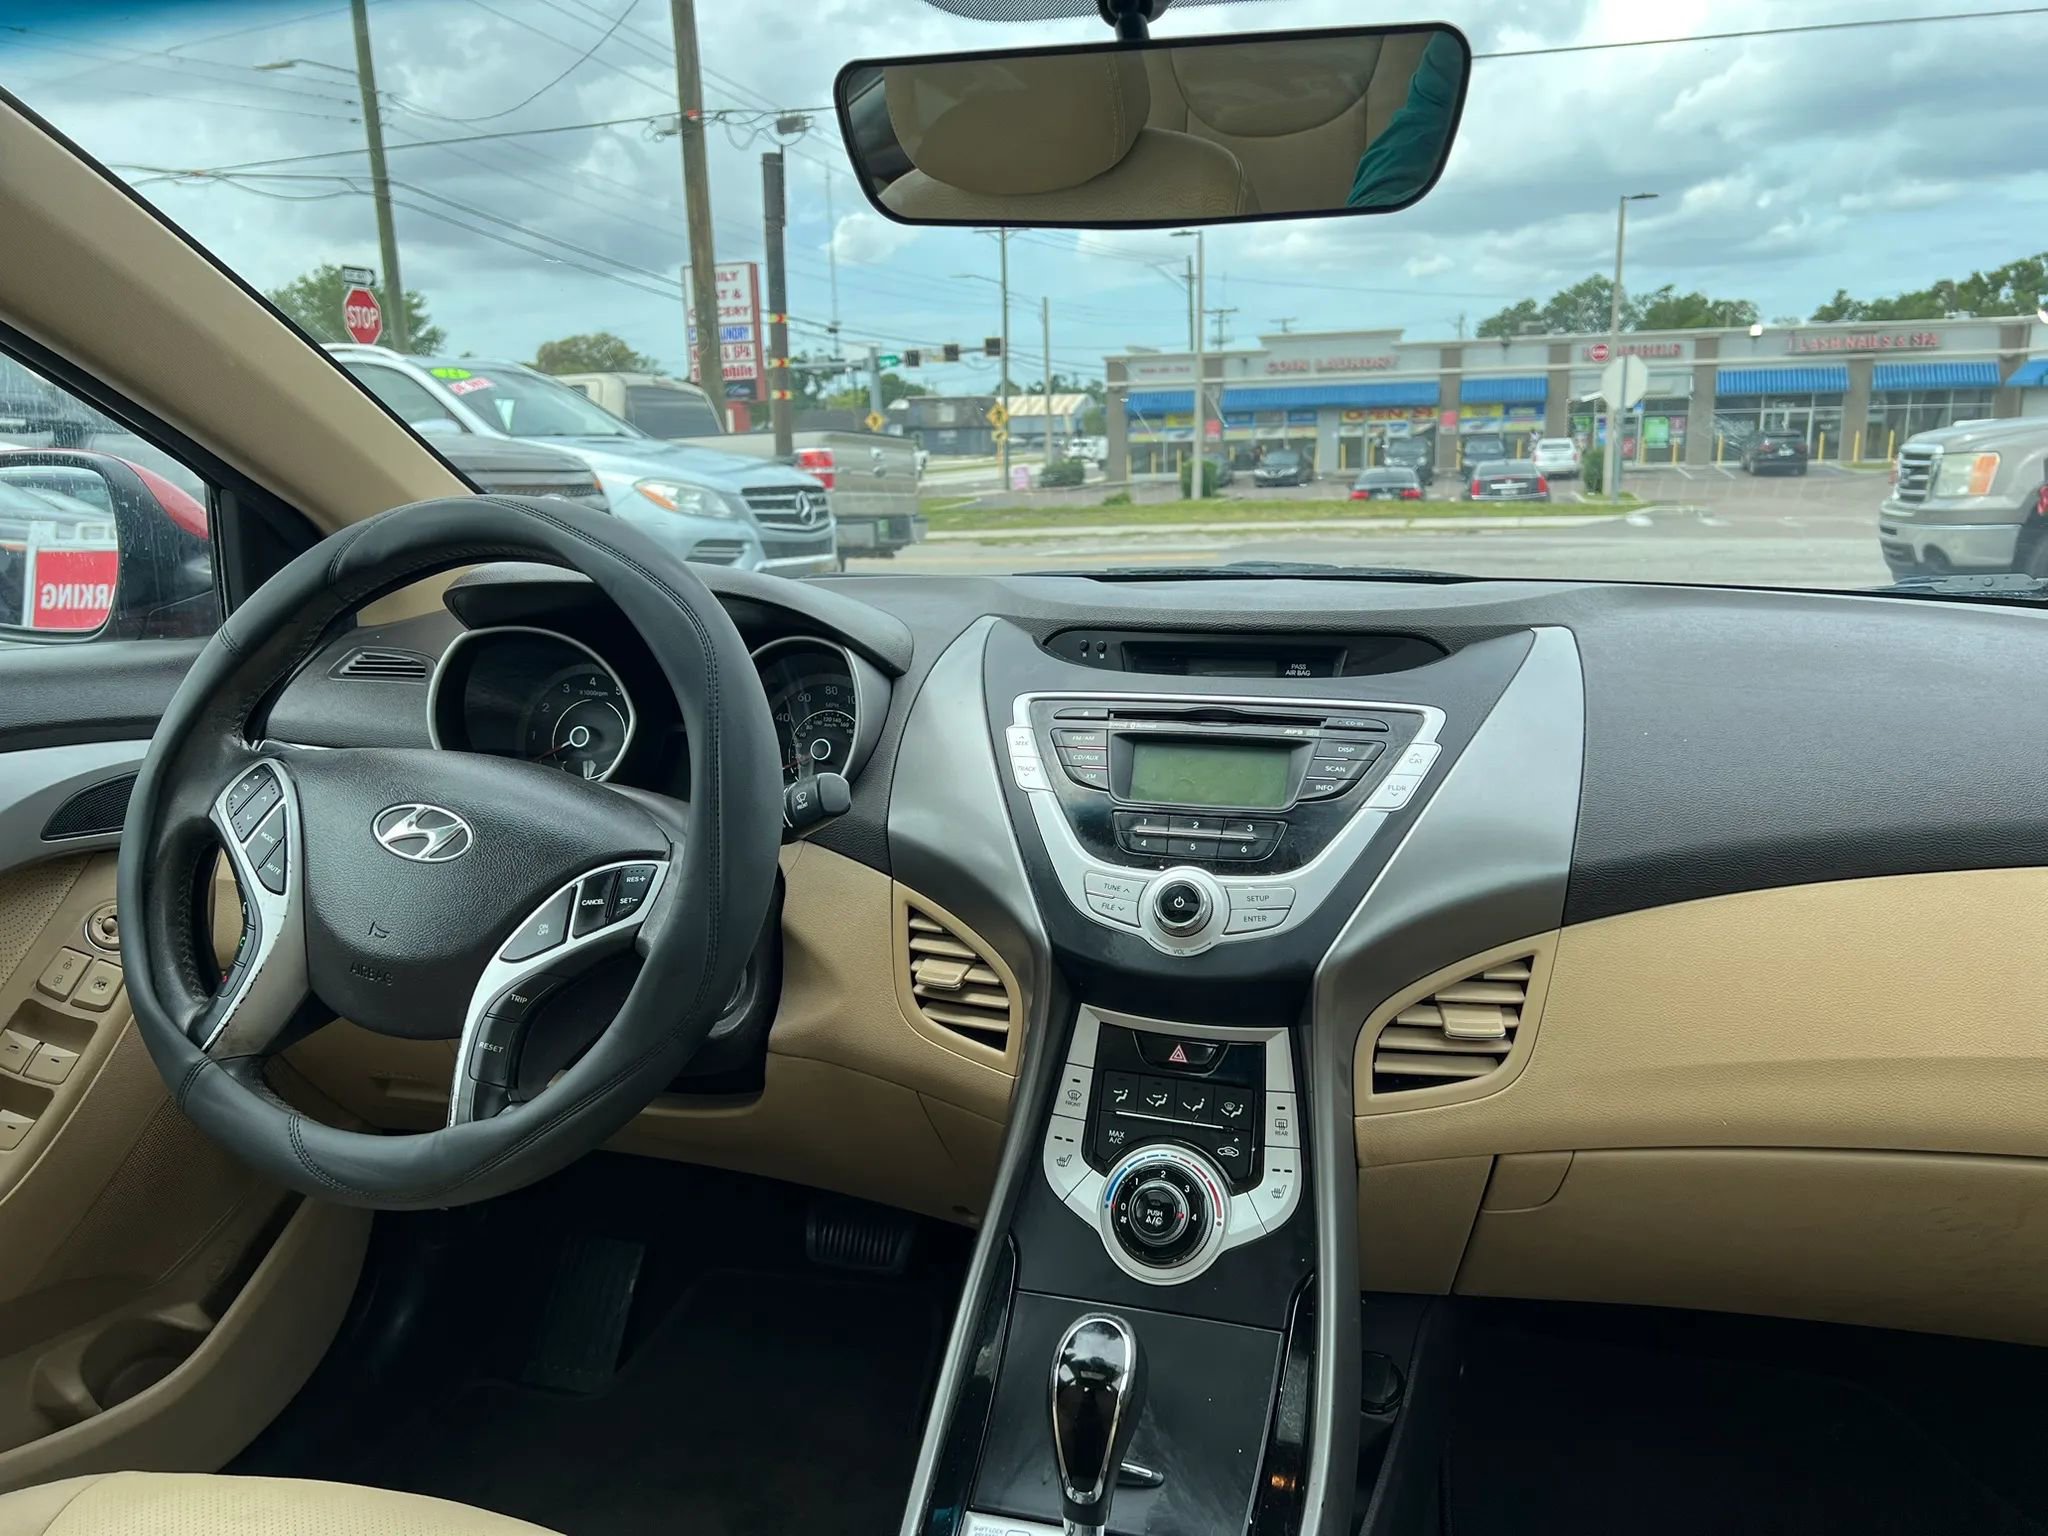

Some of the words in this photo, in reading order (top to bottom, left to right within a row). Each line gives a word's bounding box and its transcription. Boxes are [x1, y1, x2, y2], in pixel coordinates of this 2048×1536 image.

[347, 305, 379, 329] STOP
[590, 677, 597, 686] 4
[563, 683, 571, 693] 3
[825, 686, 838, 695] 80
[797, 693, 812, 702] 60
[847, 695, 856, 705] 10
[542, 702, 550, 713] 2
[776, 713, 790, 722] 40
[1325, 765, 1346, 773] SCAN
[1192, 821, 1199, 829] 2
[1246, 824, 1254, 832] 3
[260, 831, 275, 844] MODE
[1140, 839, 1147, 847] 4
[1190, 843, 1196, 851] 5
[1240, 845, 1247, 853] 6
[266, 862, 282, 876] MUTE
[1103, 883, 1121, 892] TUNE
[581, 898, 605, 906] CANCEL
[1101, 902, 1116, 911] FILE
[1243, 915, 1268, 923] ENTER
[350, 961, 393, 987] AIRBAG
[511, 993, 528, 1004] TRIP
[479, 1041, 504, 1053] RESET
[1109, 1129, 1125, 1138] MAX
[1108, 1136, 1122, 1145] A/C
[1160, 1170, 1167, 1179] 2
[1135, 1177, 1139, 1186] 1
[1184, 1184, 1190, 1193] 3
[1120, 1202, 1127, 1211] 0
[1146, 1208, 1163, 1217] PUSH
[1191, 1213, 1197, 1221] 4
[1145, 1216, 1163, 1225] A/C
